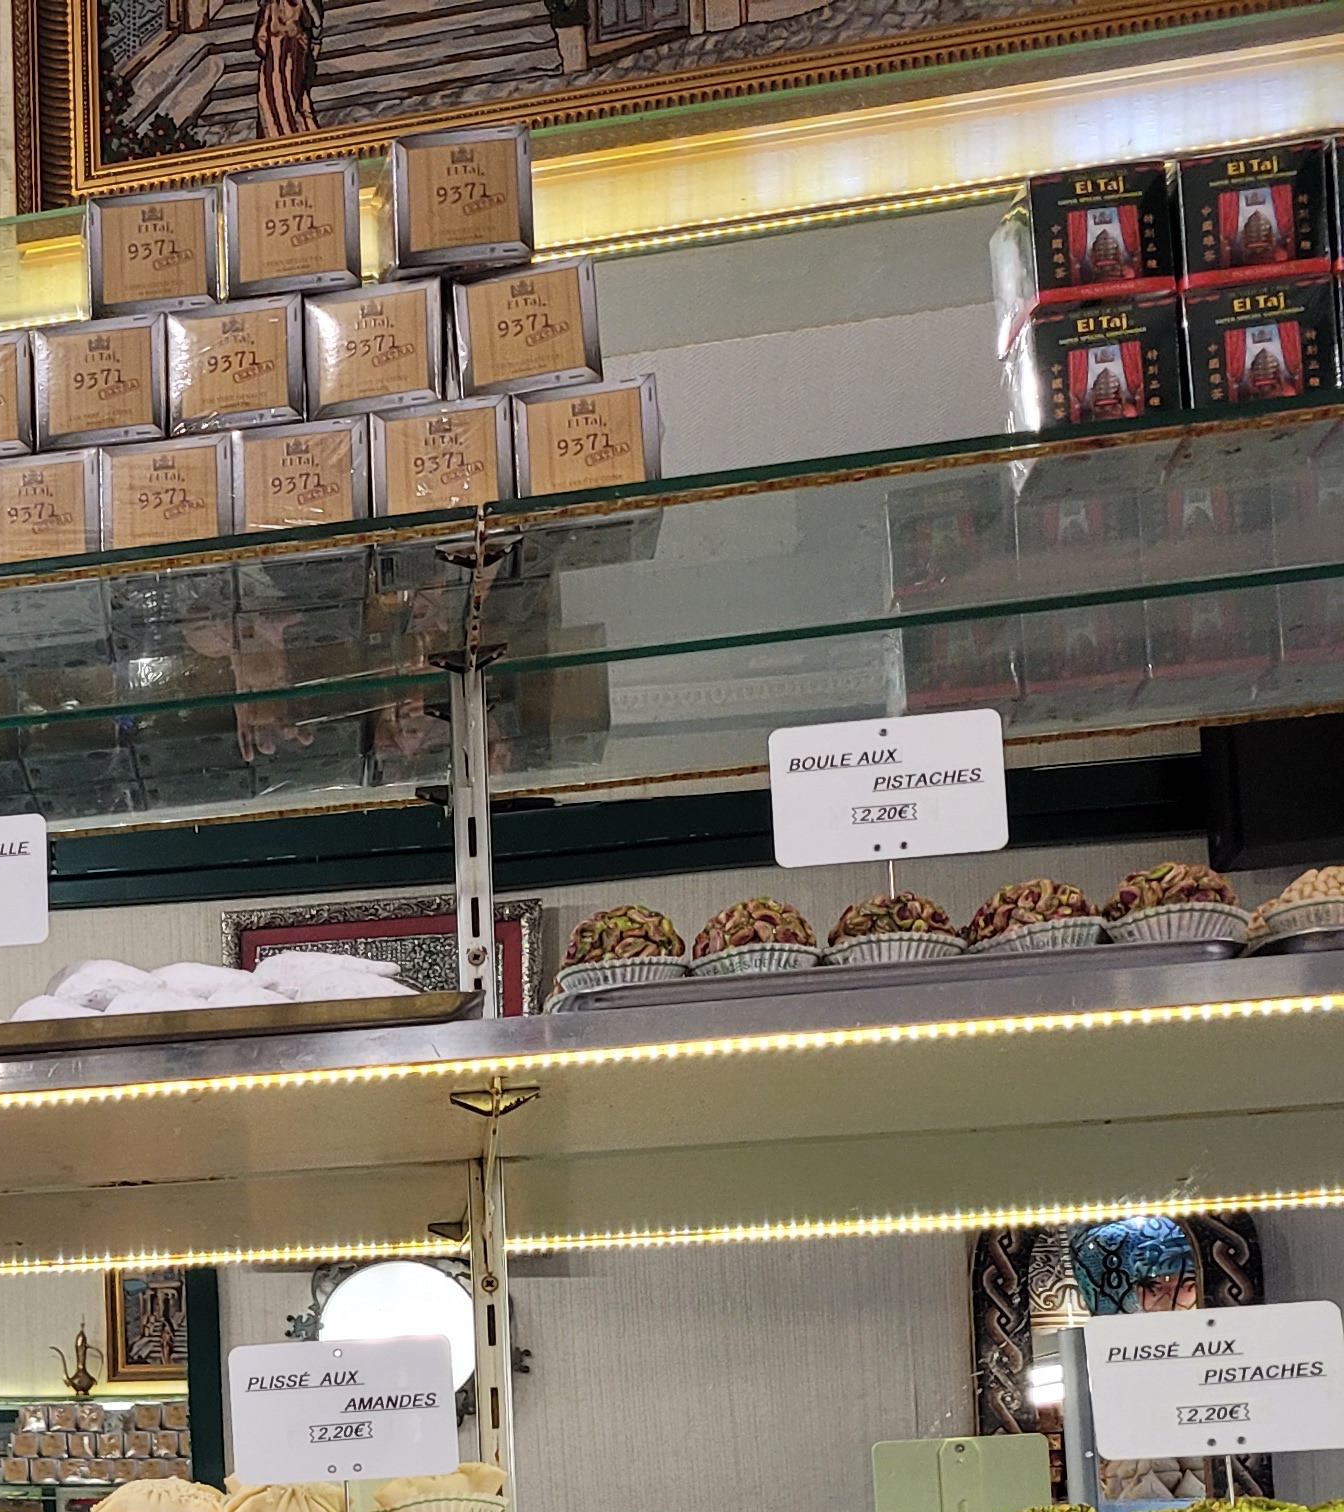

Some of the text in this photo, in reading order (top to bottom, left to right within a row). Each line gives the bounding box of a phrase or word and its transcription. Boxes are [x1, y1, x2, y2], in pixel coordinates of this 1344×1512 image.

[1227, 156, 1278, 175] El Taj
[436, 182, 491, 205] 9371
[1075, 176, 1124, 195] El Taj
[265, 214, 318, 236] 9371
[128, 239, 181, 260] 9371
[1233, 292, 1285, 313] El Taj
[497, 313, 552, 337] 9371
[1077, 313, 1129, 333] El Taj
[346, 335, 399, 358] 9371
[208, 350, 260, 373] 9371
[74, 368, 126, 390] 9371
[556, 433, 614, 457] 9371
[414, 452, 468, 474] 9371
[271, 473, 324, 495] 9371
[138, 488, 189, 509] 9371
[8, 503, 60, 524] 9371
[789, 748, 898, 772] BOULE AUX
[873, 767, 982, 791] PISTACHES
[860, 804, 909, 823] 2,20€
[1108, 1339, 1237, 1362] PLISSÉ AUX
[247, 1369, 360, 1391] PLISSÉ AUX
[1204, 1360, 1325, 1385] PISTACHES
[344, 1392, 438, 1412] AMANDES
[1186, 1405, 1242, 1424] 2,20€
[317, 1423, 366, 1442] 2,20€
